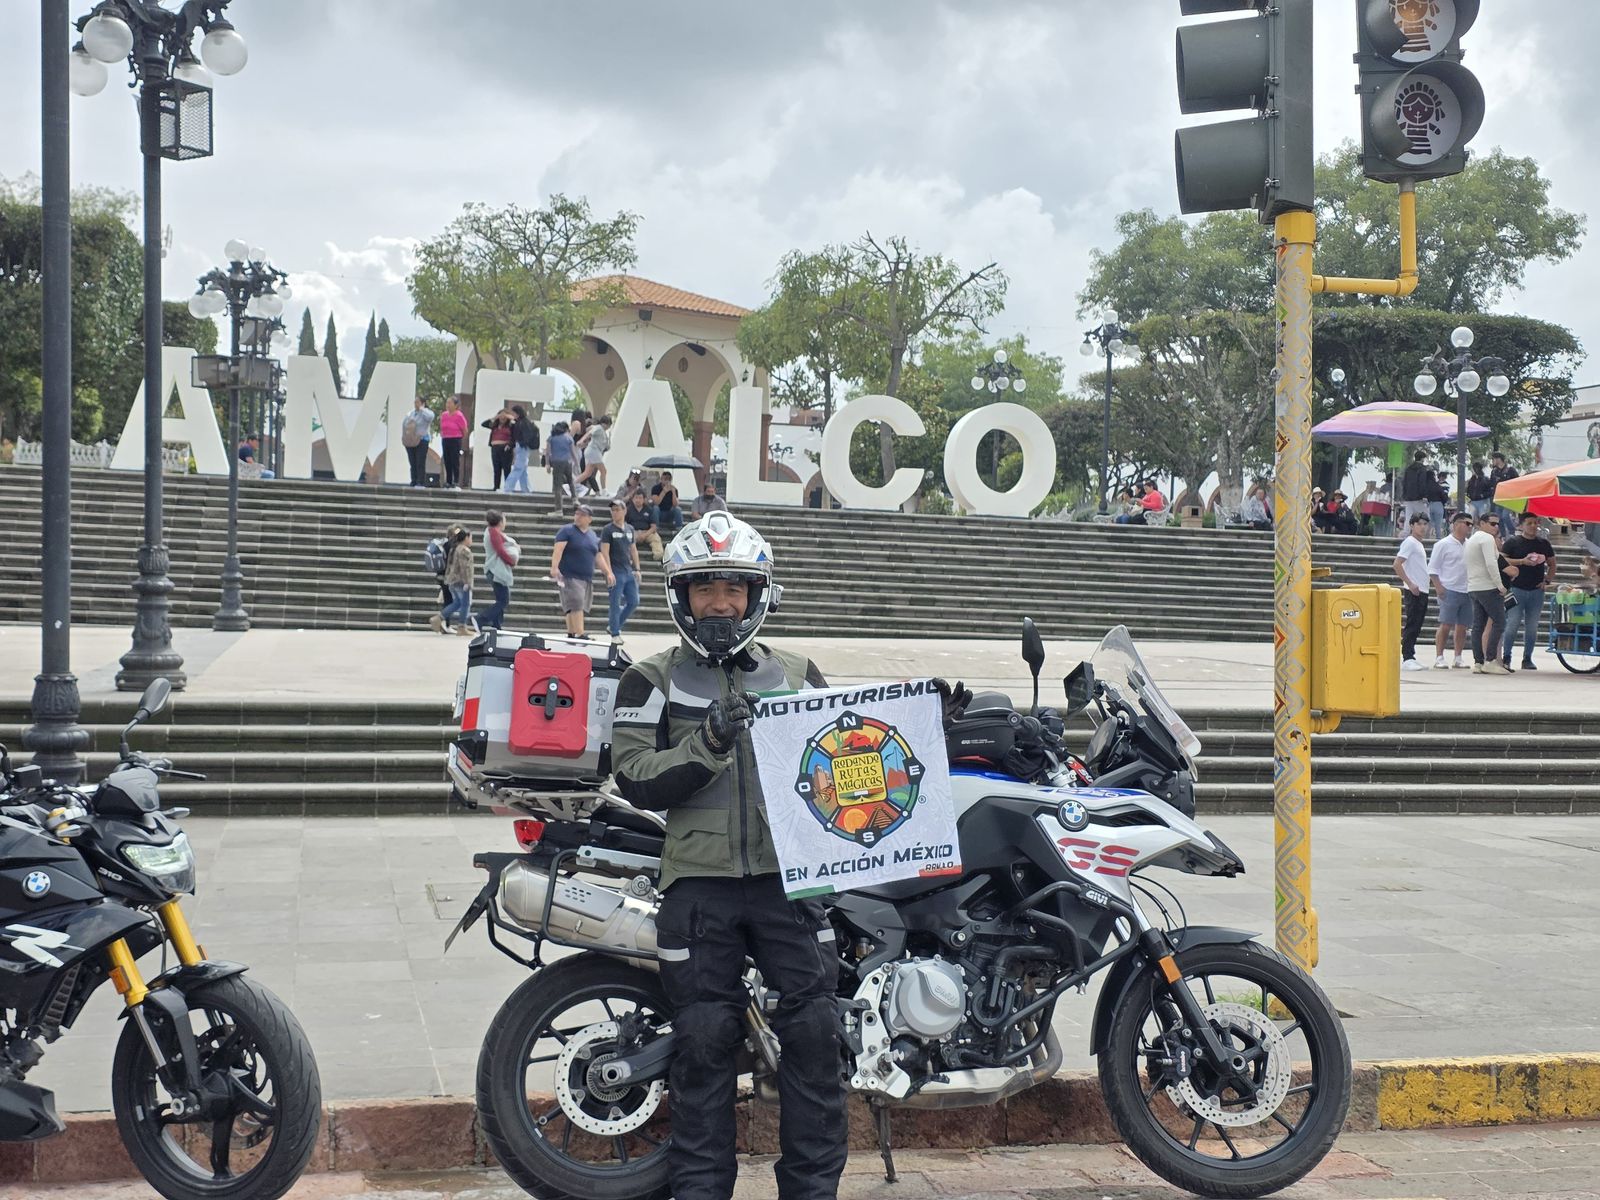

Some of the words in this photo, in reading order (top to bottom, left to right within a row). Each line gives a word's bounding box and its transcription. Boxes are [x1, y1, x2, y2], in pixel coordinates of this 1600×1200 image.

[110, 346, 1057, 518] AMEALCO
[842, 715, 857, 728] N
[908, 764, 921, 776] E
[798, 781, 811, 793] O
[862, 831, 875, 843] S
[785, 866, 808, 883] EN
[815, 852, 885, 878] ACCIÓN
[893, 842, 953, 864] MÉXICO
[97, 867, 123, 882] 310
[1085, 890, 1109, 906] GIVI
